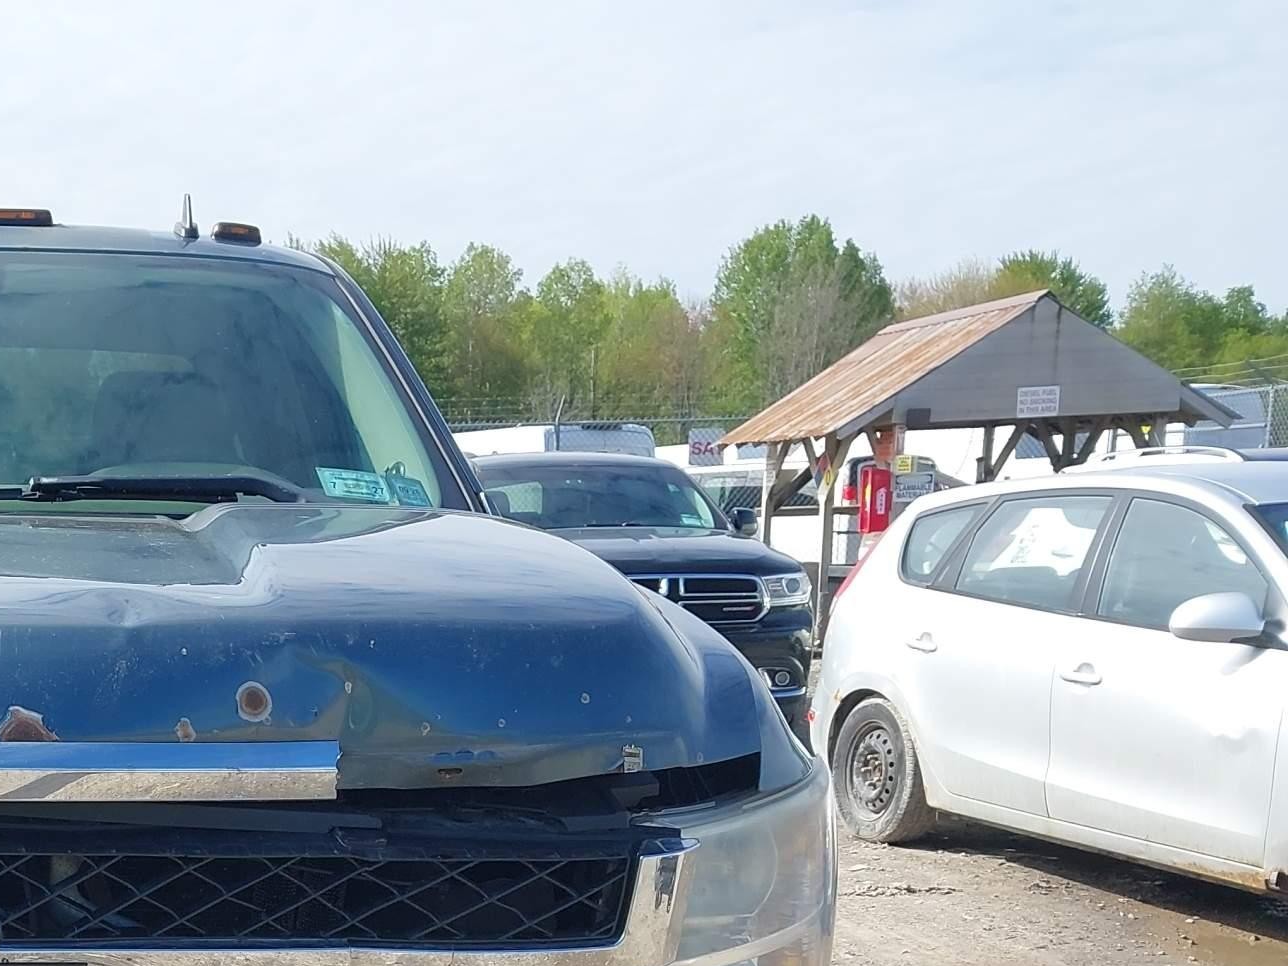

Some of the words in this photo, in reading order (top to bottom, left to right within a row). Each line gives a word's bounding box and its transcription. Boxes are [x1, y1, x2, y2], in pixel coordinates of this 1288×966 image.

[1041, 388, 1057, 397] FUEL
[1030, 398, 1057, 406] SMOKING
[1041, 404, 1057, 412] AREA
[372, 486, 385, 495] 27
